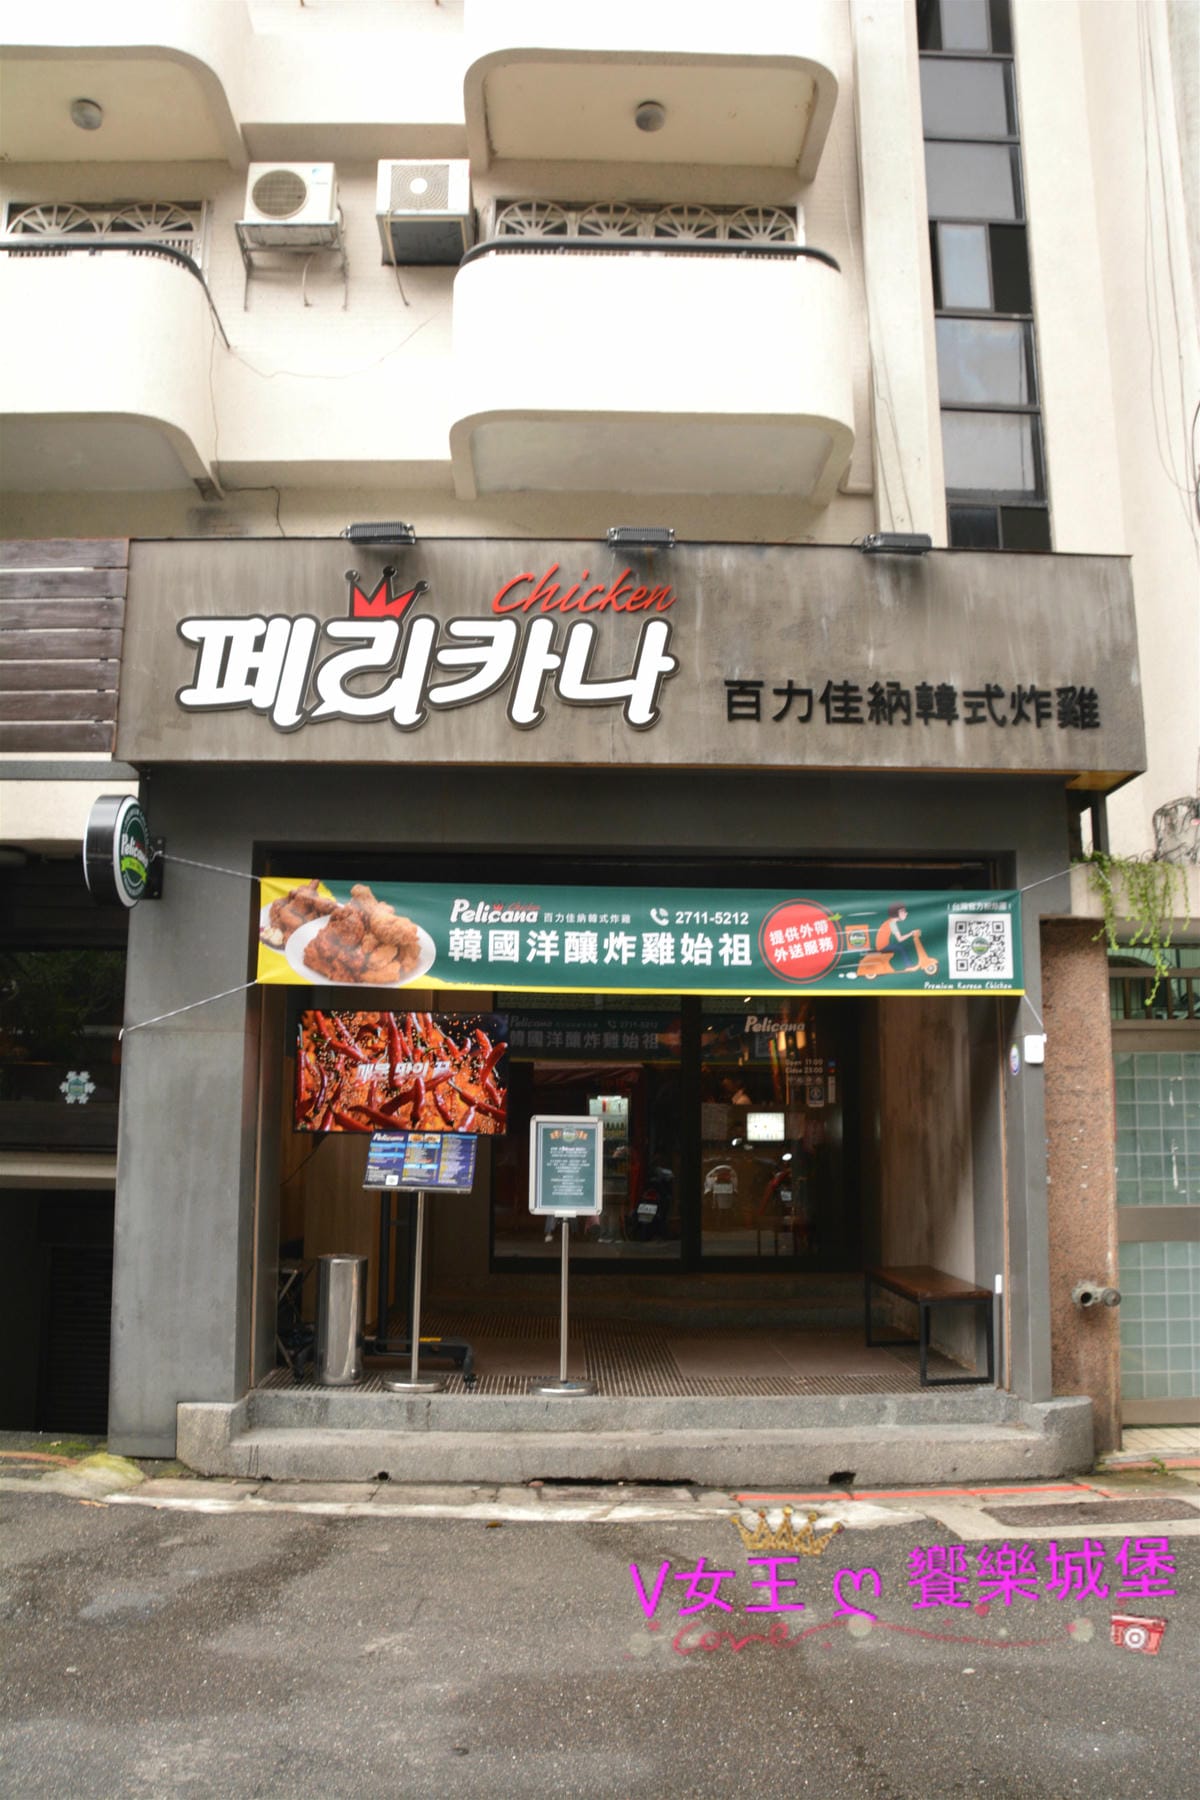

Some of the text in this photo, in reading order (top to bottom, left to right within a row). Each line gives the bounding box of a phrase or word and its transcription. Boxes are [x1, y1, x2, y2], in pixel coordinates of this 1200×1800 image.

[491, 564, 676, 614] Chicken
[176, 615, 679, 731] 페리카나
[724, 680, 1101, 730] 百力佳納韓式炸雞
[450, 898, 540, 924] Pelicana
[675, 911, 749, 925] 2711-5212
[769, 919, 829, 946] 提供外帶
[448, 928, 752, 967] 韓國洋釀炸雞始祖
[774, 937, 834, 964] 外送服務
[744, 1015, 806, 1033] Pelicana
